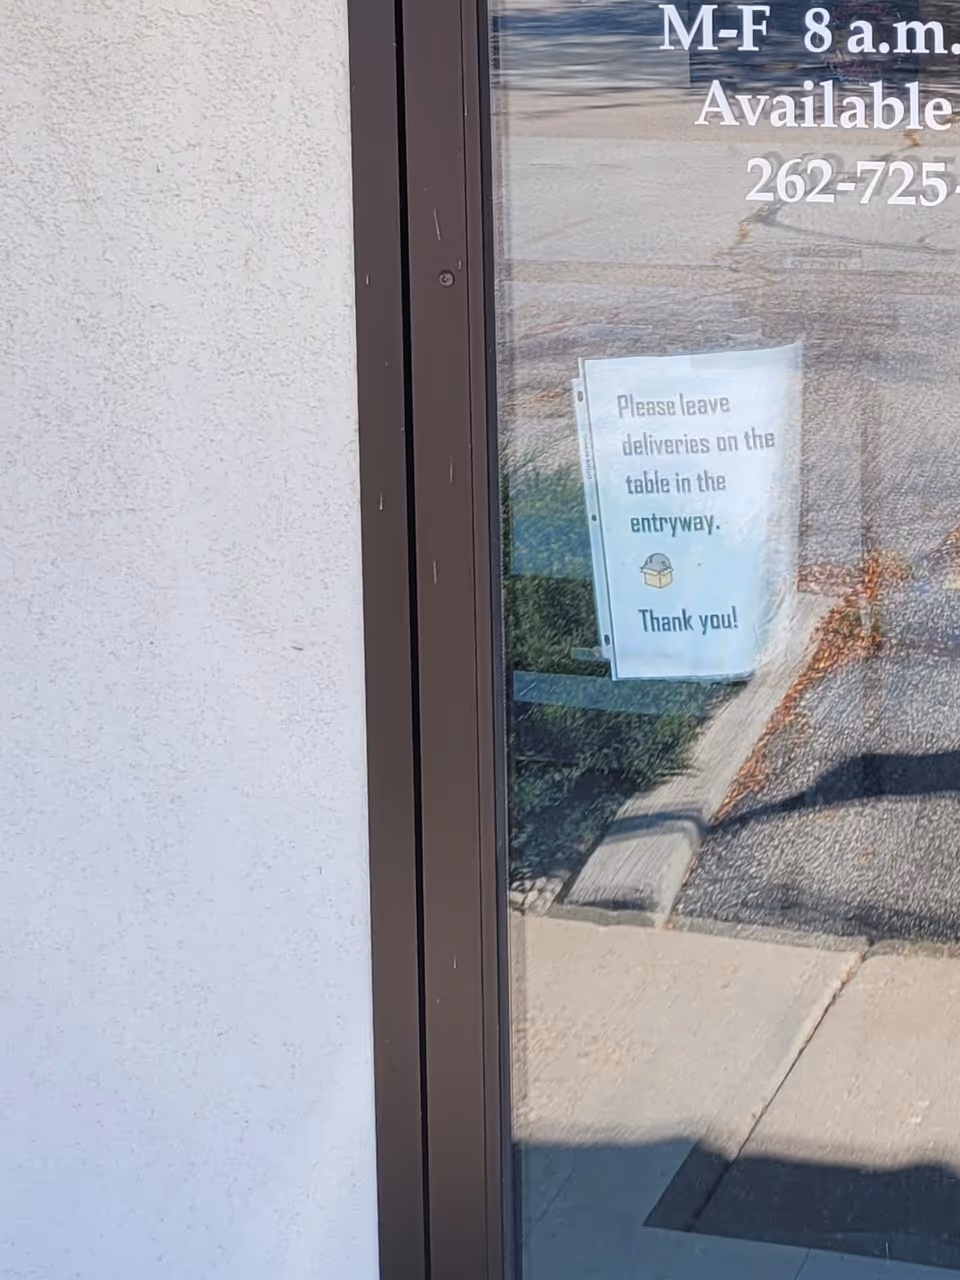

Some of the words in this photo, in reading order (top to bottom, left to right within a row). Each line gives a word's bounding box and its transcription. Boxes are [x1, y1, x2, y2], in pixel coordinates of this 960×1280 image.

[658, 4, 771, 51] M-F
[804, 7, 833, 53] 8
[693, 79, 953, 131] Available
[616, 393, 677, 419] Please
[679, 393, 731, 417] leave
[622, 431, 711, 457] deliveries
[716, 435, 739, 452] on
[743, 426, 776, 451] the
[625, 471, 671, 495] table
[674, 472, 692, 494] in
[697, 469, 727, 493] the
[630, 512, 721, 539] entryway.
[637, 607, 695, 633] Thank
[697, 605, 739, 636] you!
